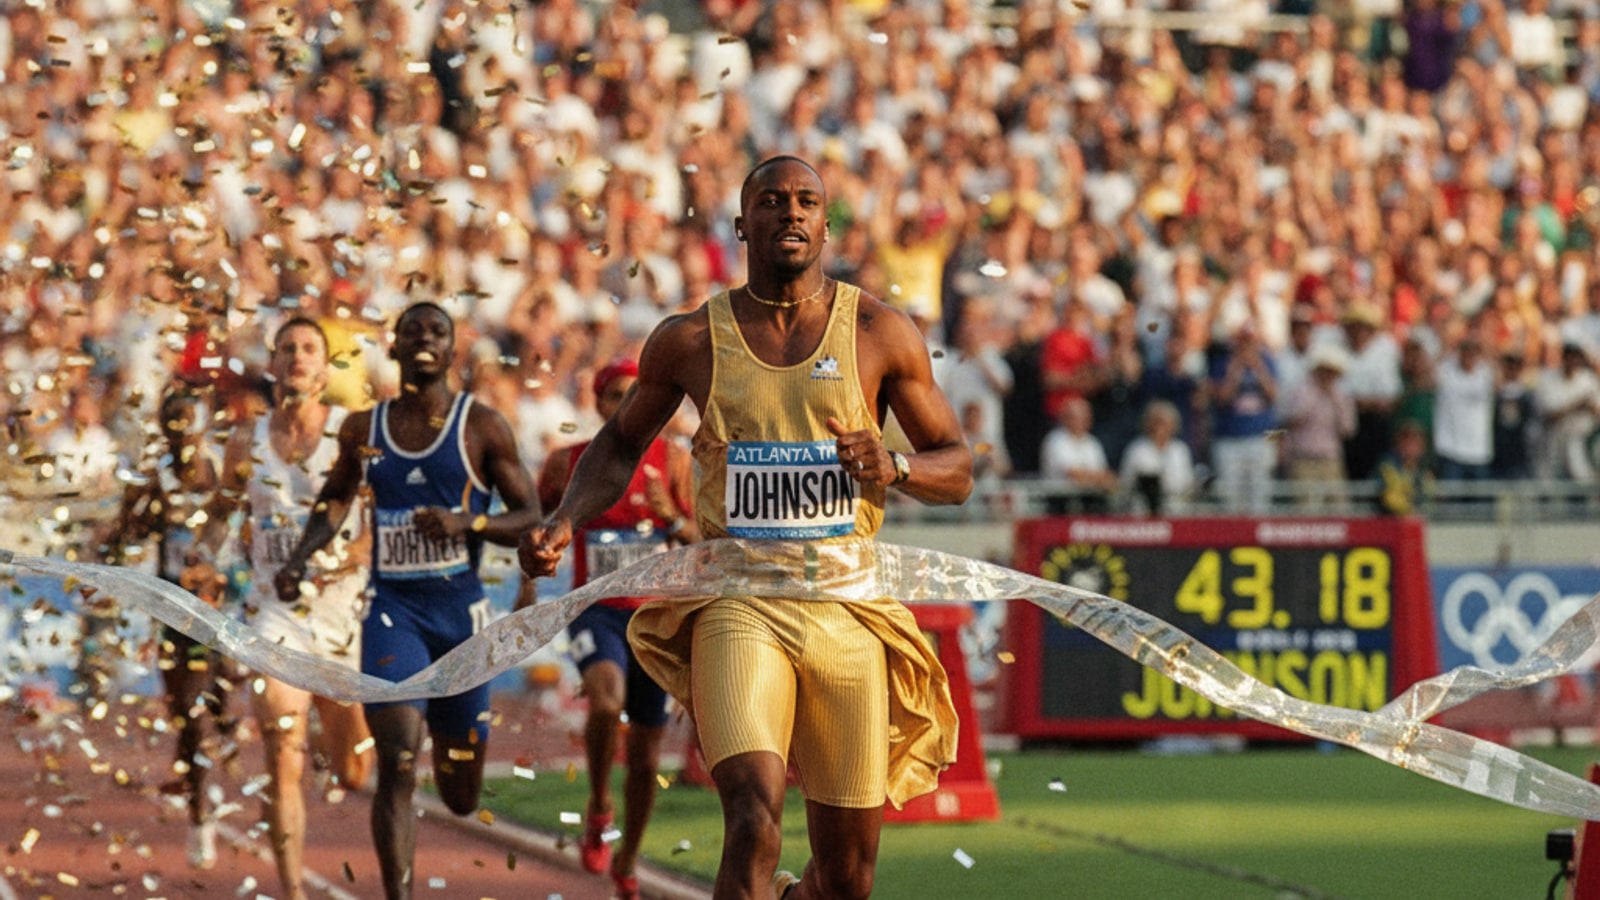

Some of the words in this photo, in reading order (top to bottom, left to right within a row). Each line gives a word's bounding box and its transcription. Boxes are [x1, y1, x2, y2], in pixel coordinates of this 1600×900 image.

[734, 446, 814, 462] ATLANTA
[729, 469, 855, 520] JOHNSON
[1318, 547, 1391, 629] 18
